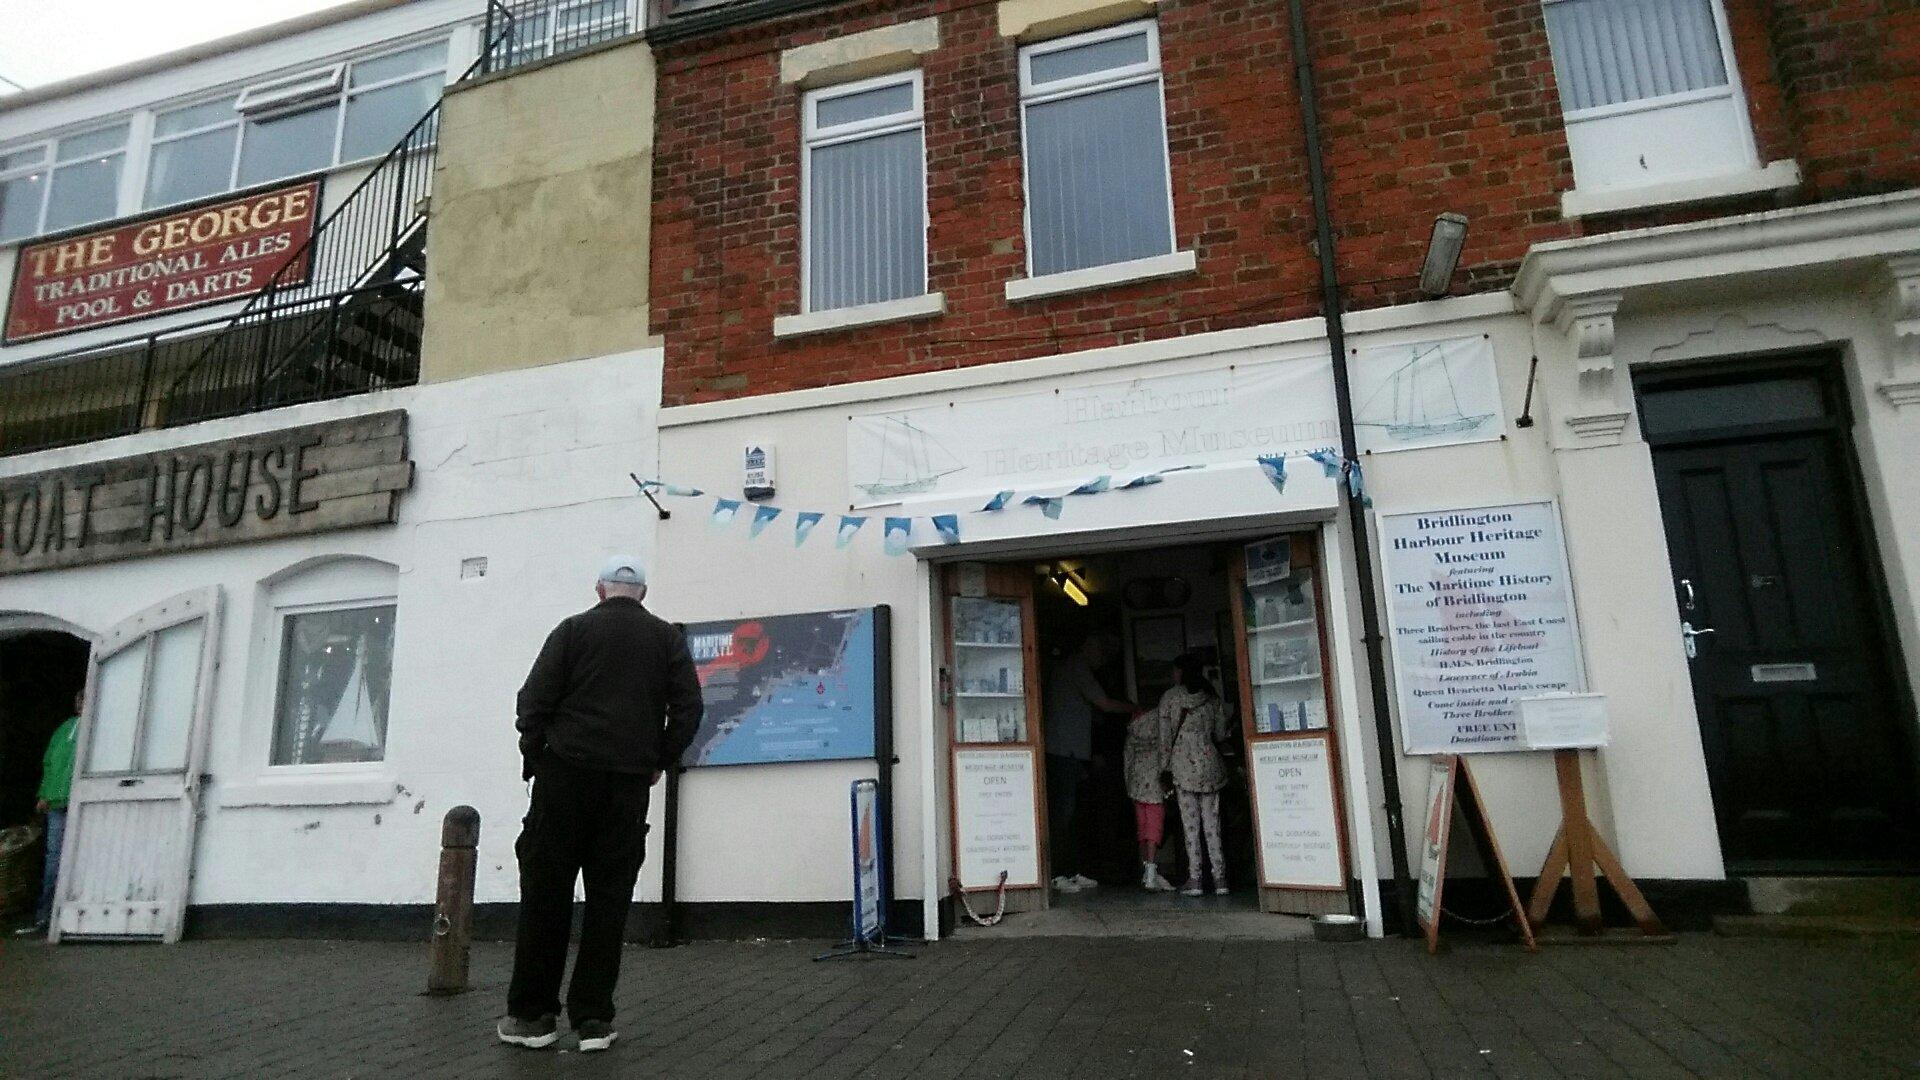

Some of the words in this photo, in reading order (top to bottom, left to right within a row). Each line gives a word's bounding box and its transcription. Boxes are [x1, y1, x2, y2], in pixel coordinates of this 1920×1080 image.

[31, 236, 115, 277] THE
[133, 191, 310, 256] GEORGE
[34, 252, 208, 301] TRADITIONAL
[220, 232, 292, 263] ALES
[57, 298, 121, 325] POOL
[132, 289, 153, 309] &
[167, 268, 252, 301] DARTS
[1063, 385, 1228, 424] Harbour
[983, 440, 1150, 477] Heritage
[1158, 419, 1336, 458] Museum
[0, 479, 105, 556] OAT
[143, 436, 322, 543] HOUSE
[1417, 512, 1512, 529] Bridlington
[1394, 536, 1464, 550] Harbour
[1470, 528, 1543, 544] Heritage
[1434, 550, 1506, 564] Museum
[1448, 566, 1495, 577] featuring
[1395, 583, 1423, 594] The
[1429, 577, 1494, 591] Maritime
[1500, 574, 1552, 586] History
[1426, 595, 1440, 608] of
[1444, 592, 1527, 606] Bridlington
[1396, 626, 1424, 635] Three
[1514, 619, 1536, 627] East
[1430, 647, 1467, 657] History
[1477, 657, 1534, 666] Bridlington
[1413, 687, 1445, 698] Queen
[1447, 685, 1495, 694] Henrietta
[1427, 700, 1453, 709] Come
[1456, 698, 1485, 707] inside
[1442, 710, 1472, 719] Three
[1457, 724, 1491, 733] FREE
[983, 776, 1007, 785] OPEN
[1278, 768, 1302, 778] OPEN
